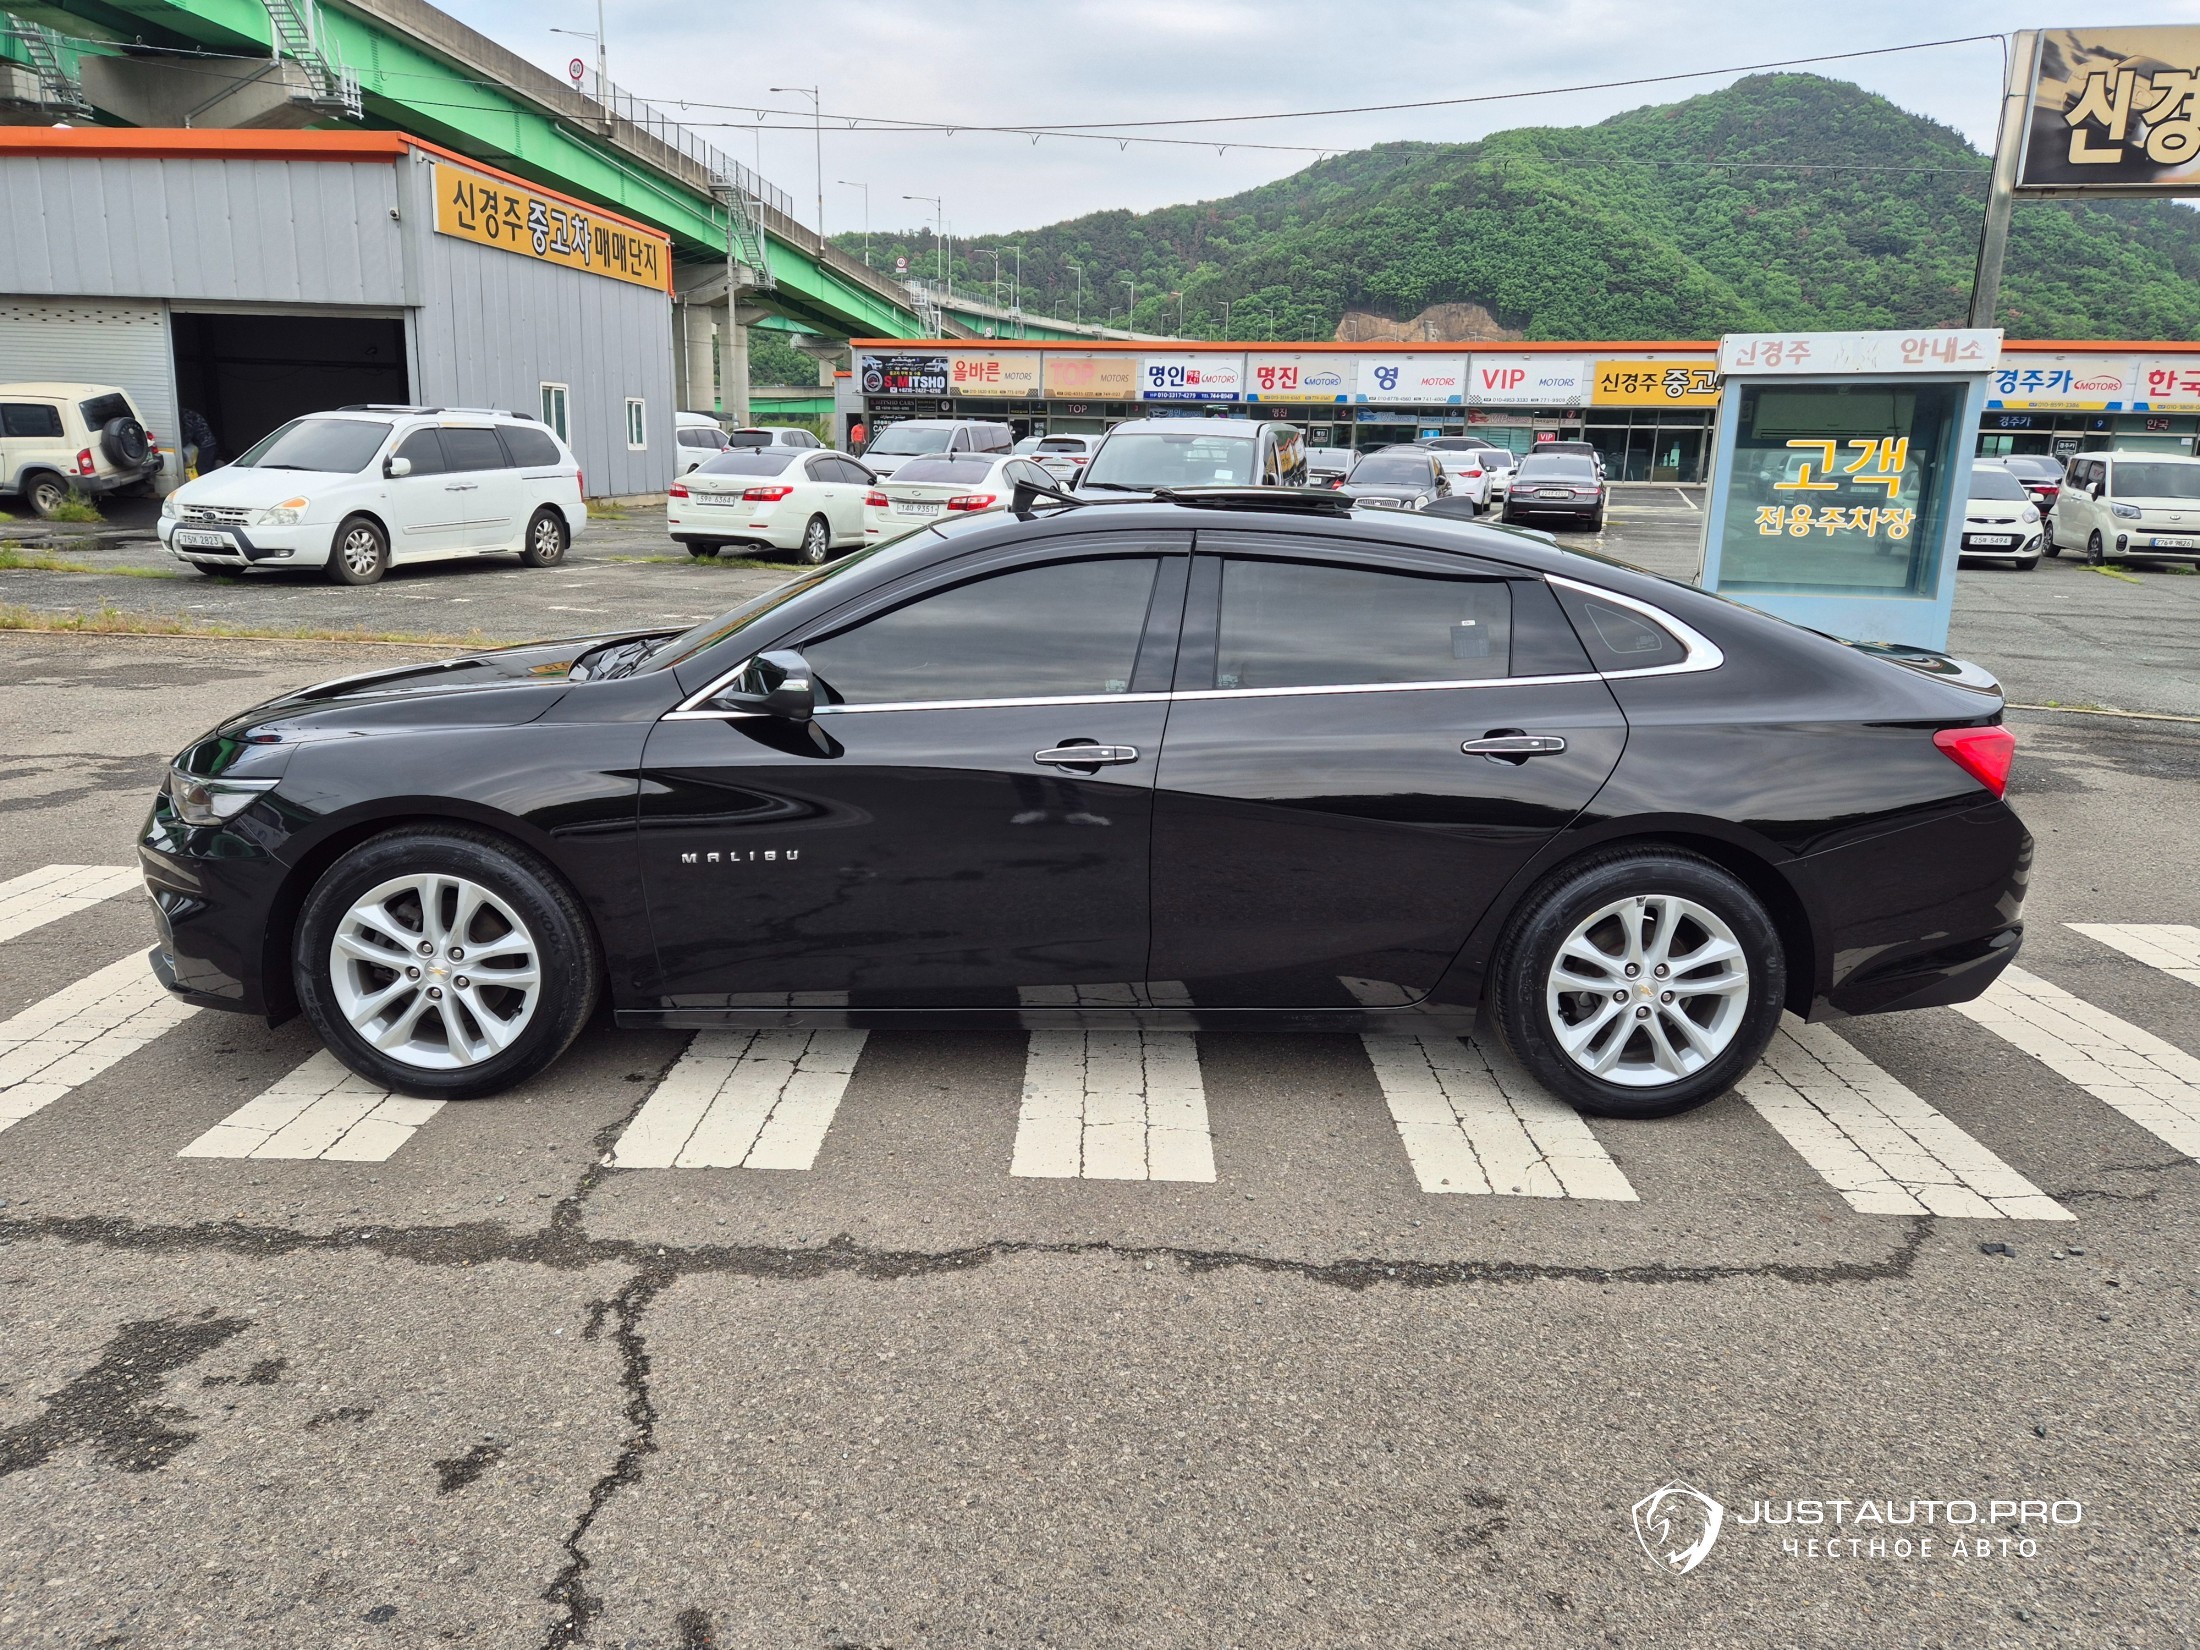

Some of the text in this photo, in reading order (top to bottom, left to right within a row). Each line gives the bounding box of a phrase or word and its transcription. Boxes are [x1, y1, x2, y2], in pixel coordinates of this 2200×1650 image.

[453, 180, 657, 280] 신경주 중고차 매매단지
[1735, 336, 1984, 367] 신경주 안내소
[952, 360, 1001, 382] 올바른
[1004, 372, 1032, 380] MOTORS
[1051, 362, 1129, 386] TOP MOTORS
[1148, 365, 1185, 387] 명인
[1205, 375, 1235, 383] MOTORS
[1257, 366, 1298, 390] 명진
[1308, 377, 1339, 386] MOTORS
[1374, 366, 1399, 390] 영
[1421, 377, 1456, 386] MOTORS
[1482, 368, 1575, 389] VIP MOTORS
[1600, 368, 1722, 398] 신경주 중고
[1995, 369, 2074, 394] 경주카
[2148, 369, 2200, 397] 한국
[2079, 381, 2119, 391] MOTORS
[1067, 404, 1088, 413] TOP
[1271, 408, 1288, 418] 명진
[1450, 408, 1457, 417] 6
[1999, 416, 2032, 427] 경주카
[2096, 419, 2103, 428] 9
[1540, 433, 1553, 441] VIP
[1773, 436, 1909, 499] 고객
[714, 496, 731, 504] 6364
[916, 505, 934, 513] 9351
[1754, 504, 1916, 540] 전용주차장
[199, 535, 219, 545] 2823
[681, 850, 799, 864] MALIBU
